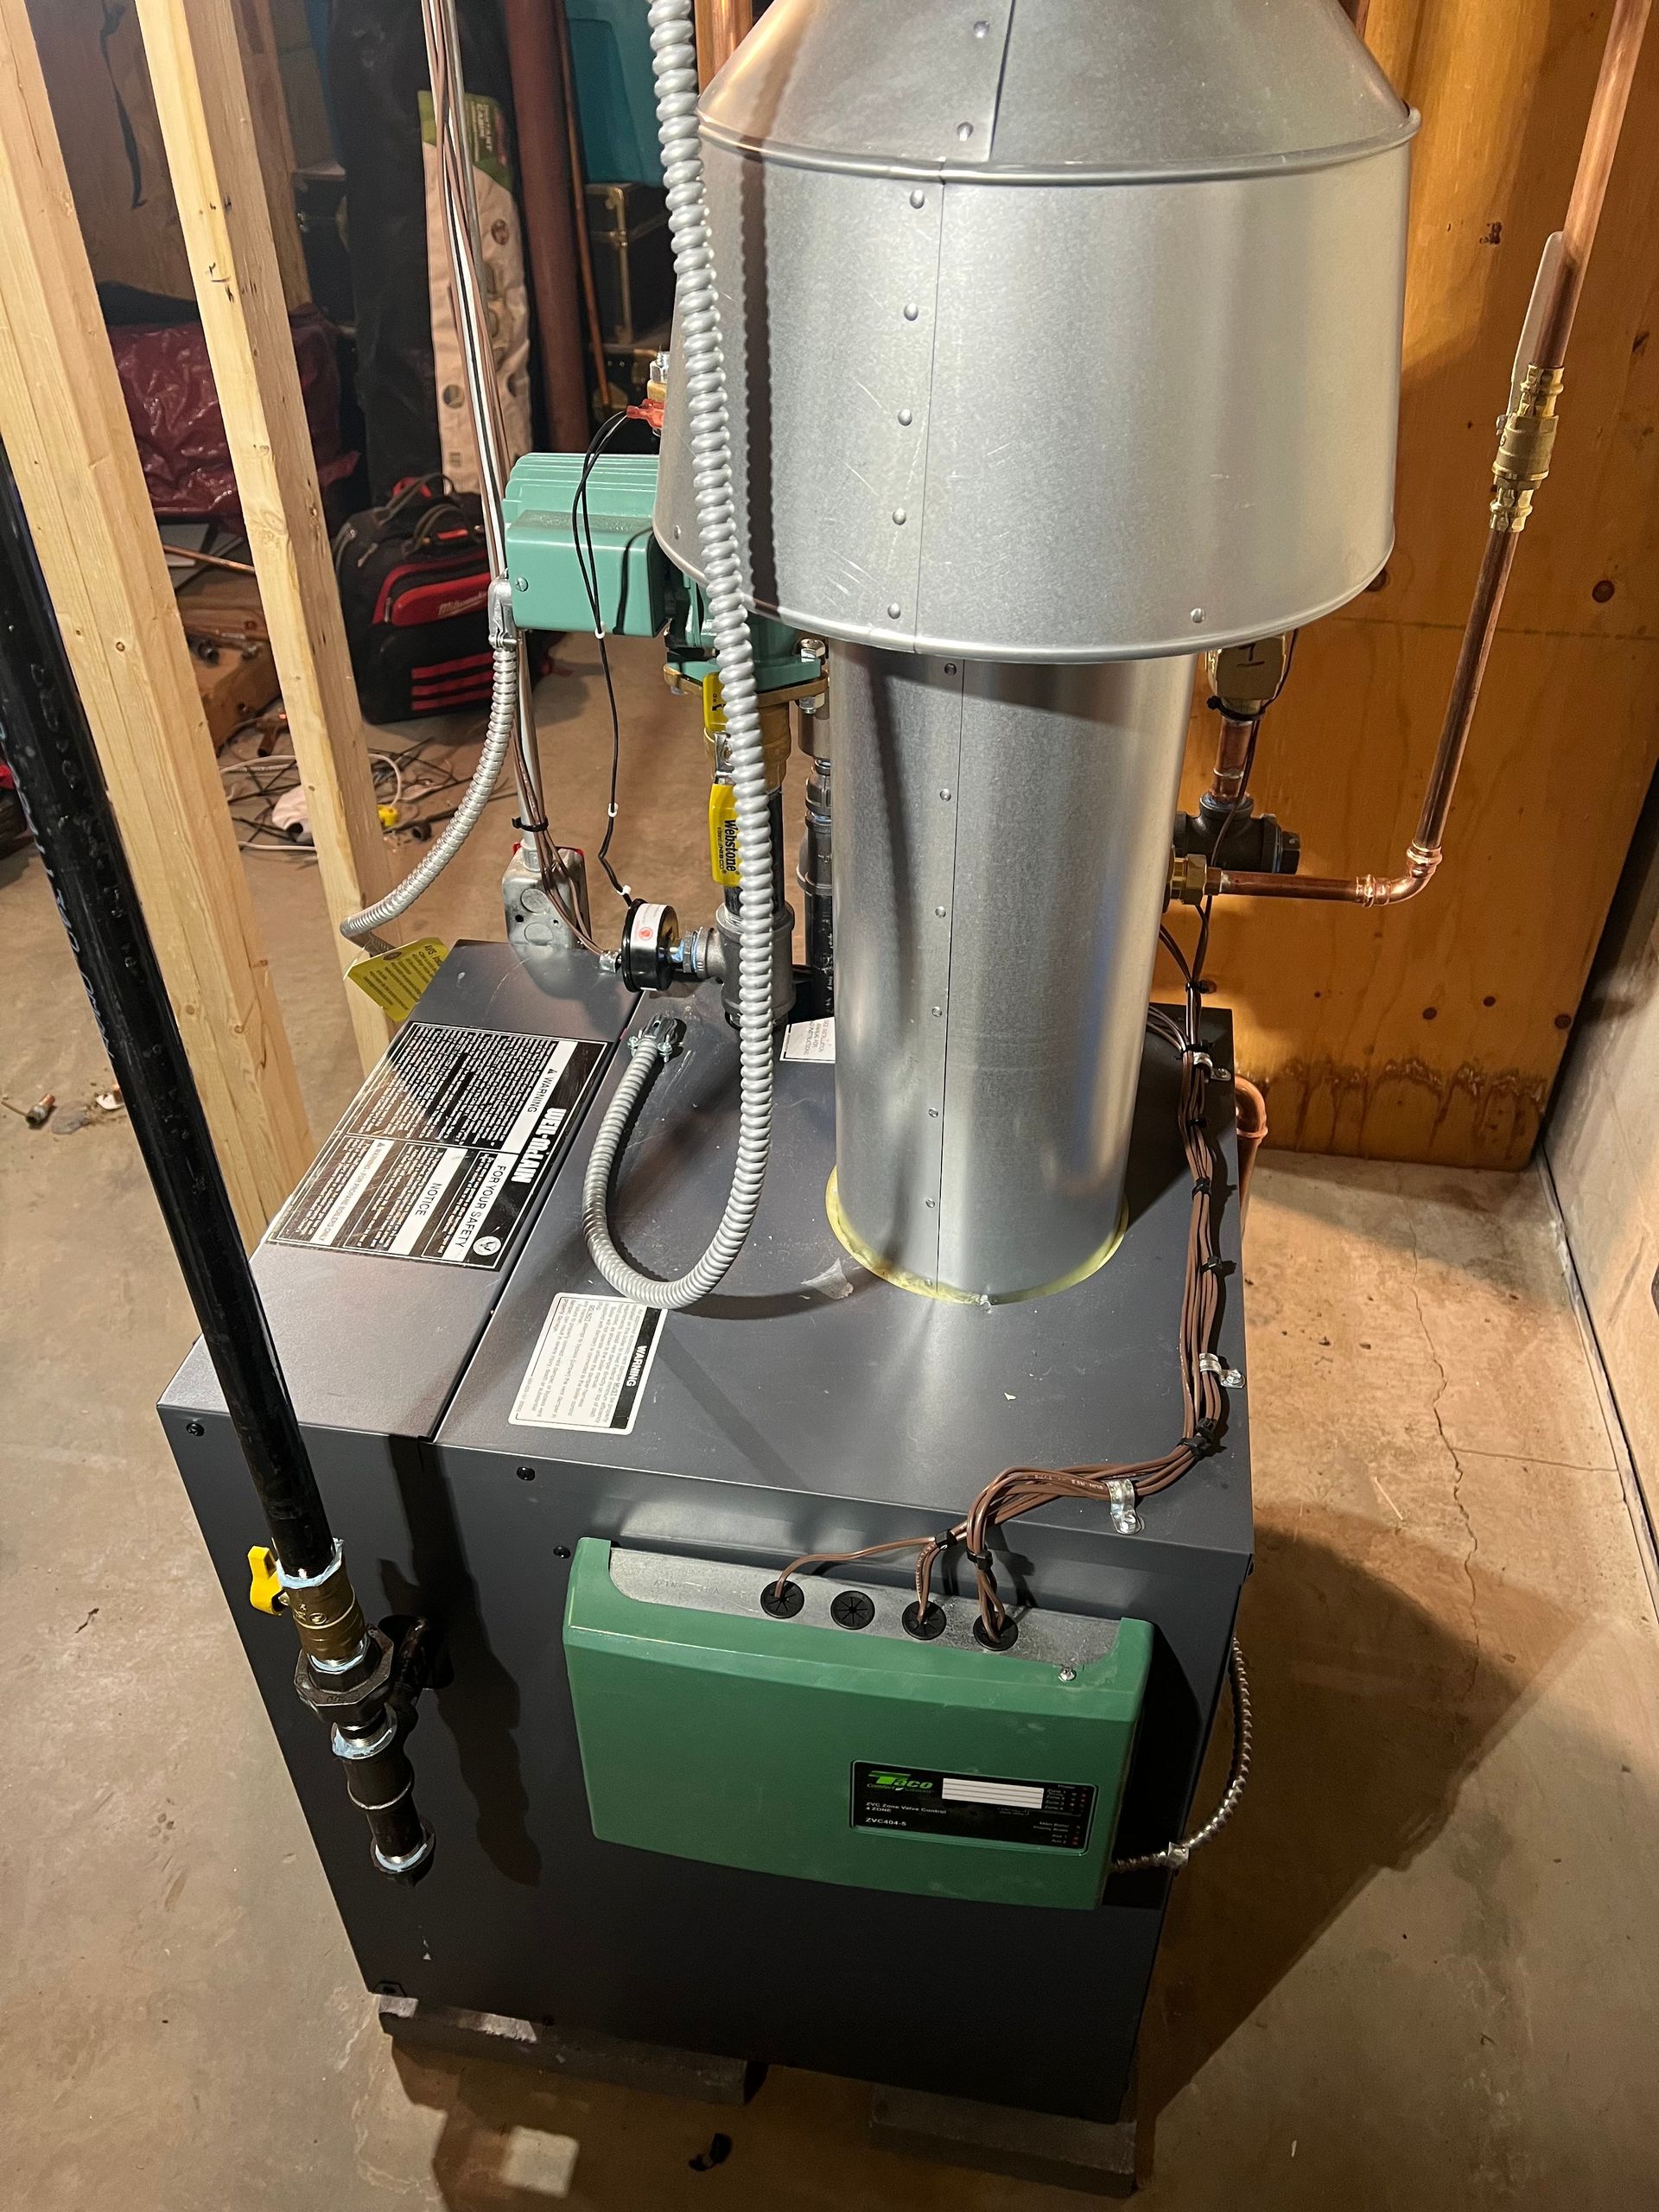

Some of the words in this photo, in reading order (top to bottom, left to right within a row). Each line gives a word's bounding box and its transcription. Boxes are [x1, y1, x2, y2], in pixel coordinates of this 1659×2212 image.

[724, 819, 740, 871] Webstone
[524, 1077, 554, 1114] WARNING
[489, 1165, 505, 1185] FOR
[415, 1182, 442, 1217] NOTICE
[474, 1185, 496, 1210] YOUR
[455, 1211, 481, 1248] SAFETY
[625, 1344, 648, 1387] WARNING
[868, 1770, 933, 1789] Taco
[865, 1816, 906, 1827] ZVC404-5
